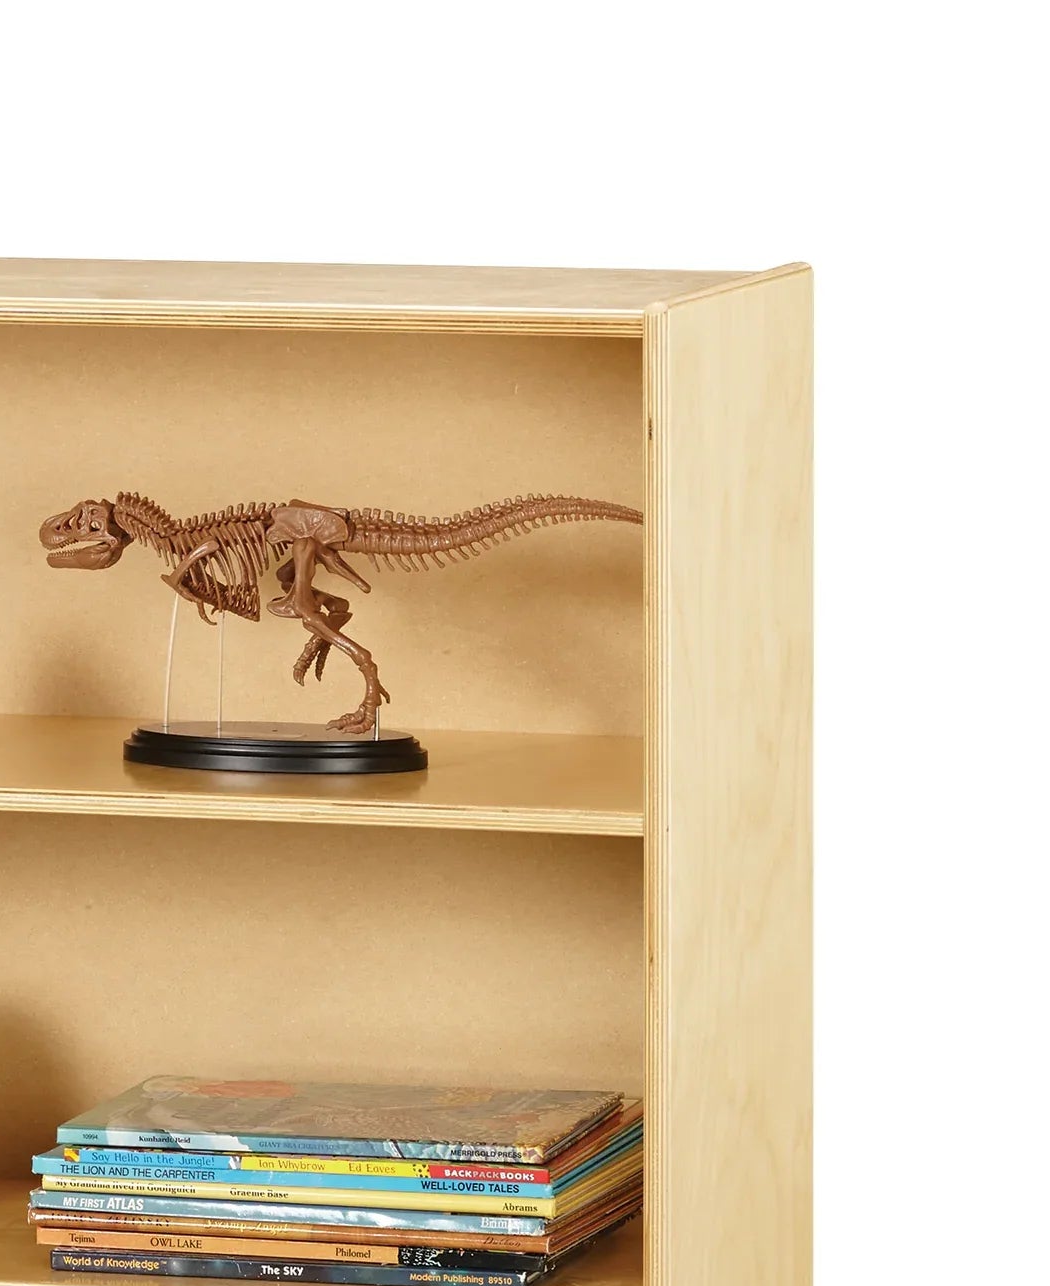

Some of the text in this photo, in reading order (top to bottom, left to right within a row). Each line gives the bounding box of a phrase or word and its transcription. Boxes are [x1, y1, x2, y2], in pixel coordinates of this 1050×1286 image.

[91, 1152, 110, 1164] Say
[114, 1152, 139, 1163] Hello
[144, 1153, 153, 1163] in
[158, 1154, 174, 1165] the
[497, 1151, 523, 1159] PRESS
[279, 1161, 326, 1171] Whybrow
[348, 1163, 396, 1174] Ed Eaves
[60, 1164, 215, 1180] THE LION AND THE CARPENTER
[421, 1180, 520, 1194] WELL-LOVED TALES
[62, 1197, 144, 1211] MY FIRST ATLAS
[502, 1202, 538, 1212] Abrams
[69, 1233, 96, 1244] Tejima
[150, 1237, 202, 1249] OWL LAKE
[335, 1247, 371, 1259] Philomel
[63, 1256, 91, 1267] World
[94, 1257, 105, 1267] of
[261, 1265, 304, 1276] The SKY
[410, 1273, 513, 1285] Modern Publishing 89510
